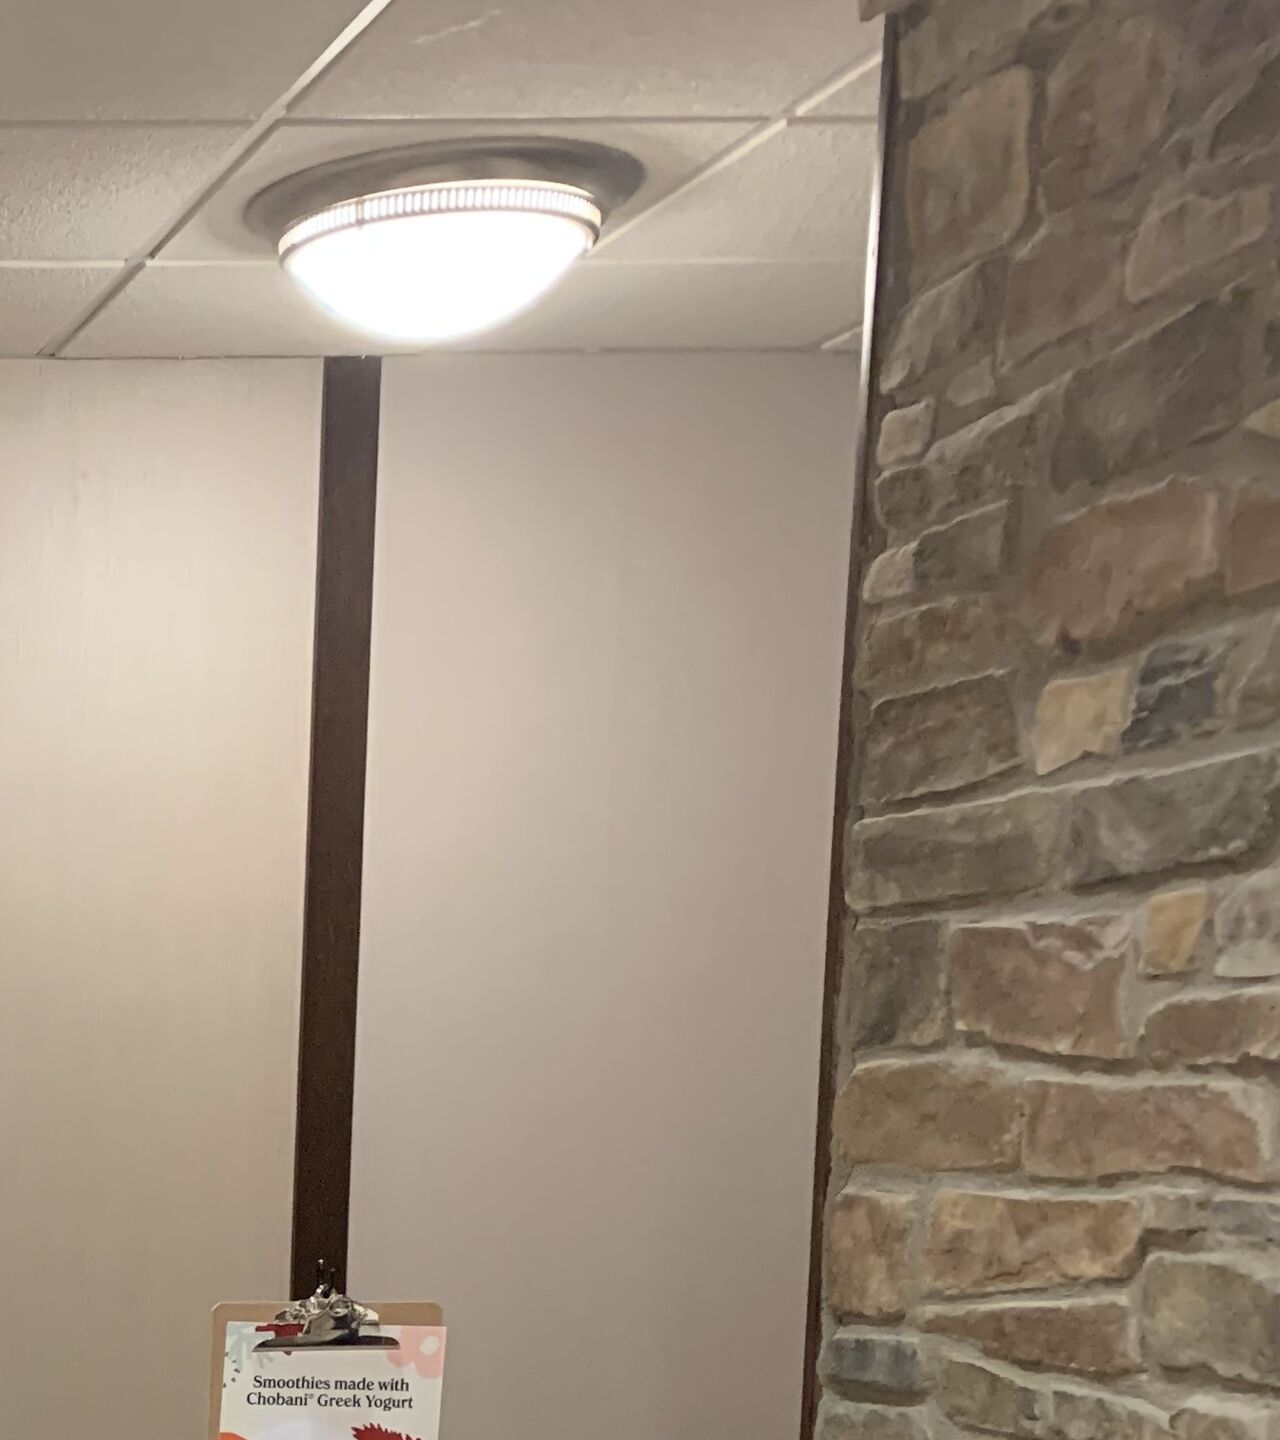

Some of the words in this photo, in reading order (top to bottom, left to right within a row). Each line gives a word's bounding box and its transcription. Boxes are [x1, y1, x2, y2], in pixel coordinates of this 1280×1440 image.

[252, 1374, 331, 1391] Smoothies
[334, 1376, 375, 1392] made
[377, 1377, 410, 1392] with
[316, 1393, 362, 1409] Greek
[365, 1394, 414, 1412] Yogurt
